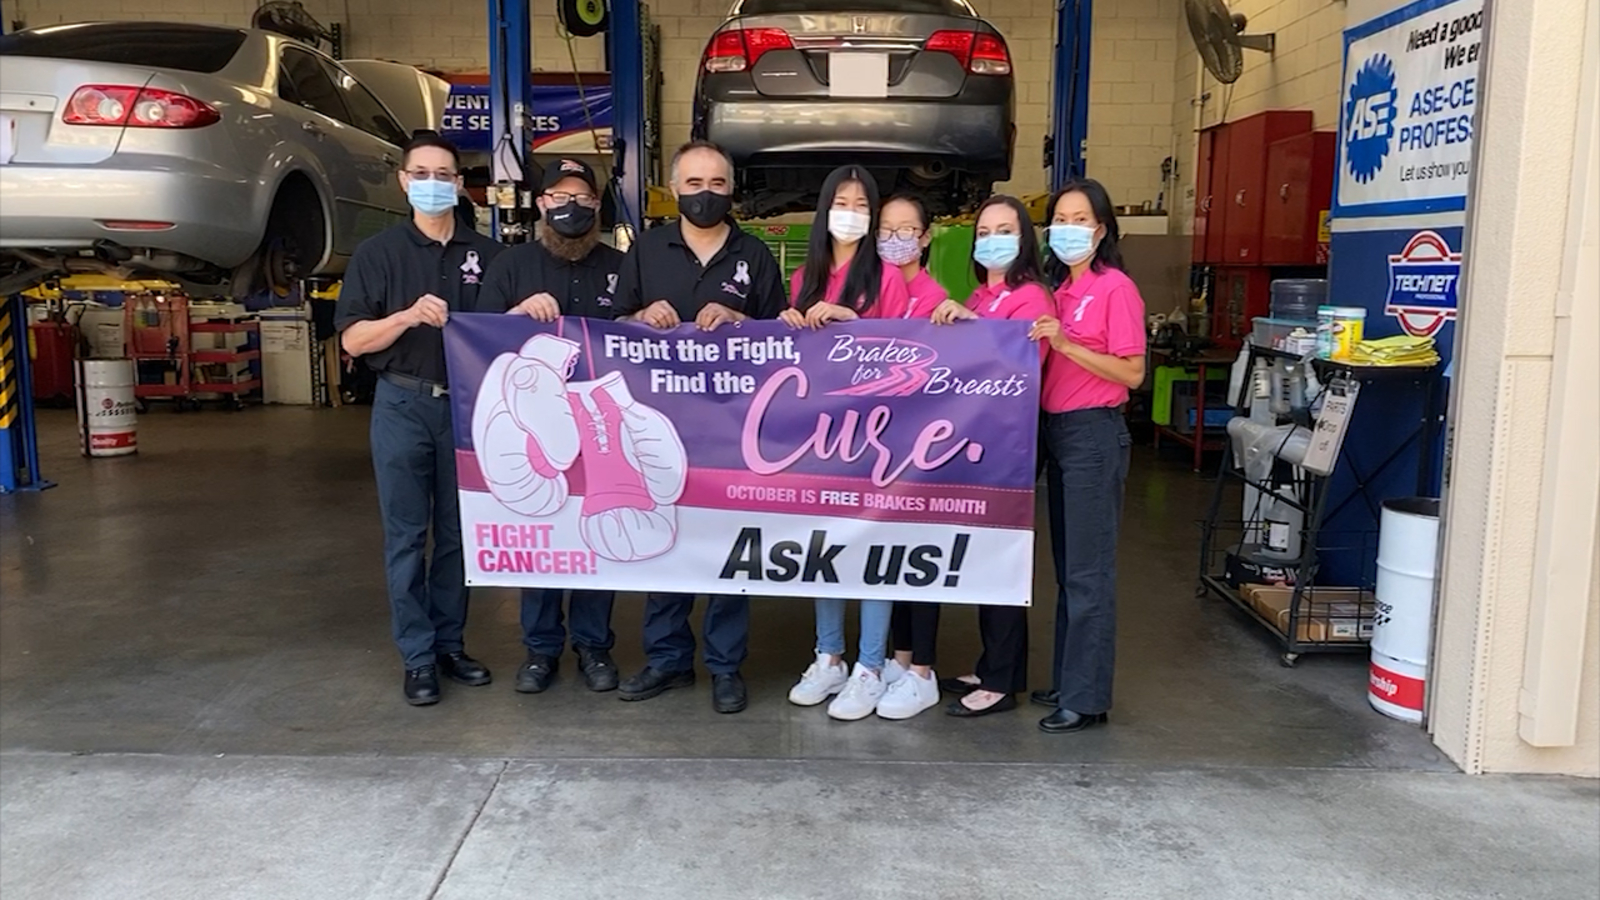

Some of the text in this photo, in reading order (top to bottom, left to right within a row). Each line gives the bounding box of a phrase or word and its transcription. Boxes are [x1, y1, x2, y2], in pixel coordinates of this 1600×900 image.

[1406, 21, 1440, 53] Need
[1440, 22, 1449, 42] a
[1444, 44, 1466, 70] We
[1409, 78, 1475, 118] ASE-CE
[1348, 91, 1391, 142] ASE
[1400, 164, 1415, 182] Let
[1416, 166, 1427, 180] us
[1428, 161, 1450, 179] show
[604, 334, 801, 365] Fight the Fight,
[827, 334, 922, 364] Brakes
[650, 368, 756, 394] Find the
[851, 364, 884, 385] for
[922, 366, 1028, 397] Breasts
[741, 366, 984, 487] Cure.
[726, 484, 987, 515] OCTOBER IS FREE BRAKES MONTH
[475, 523, 554, 549] FIGHT
[478, 549, 598, 575] CANCER!
[718, 526, 971, 588] Ask us!
